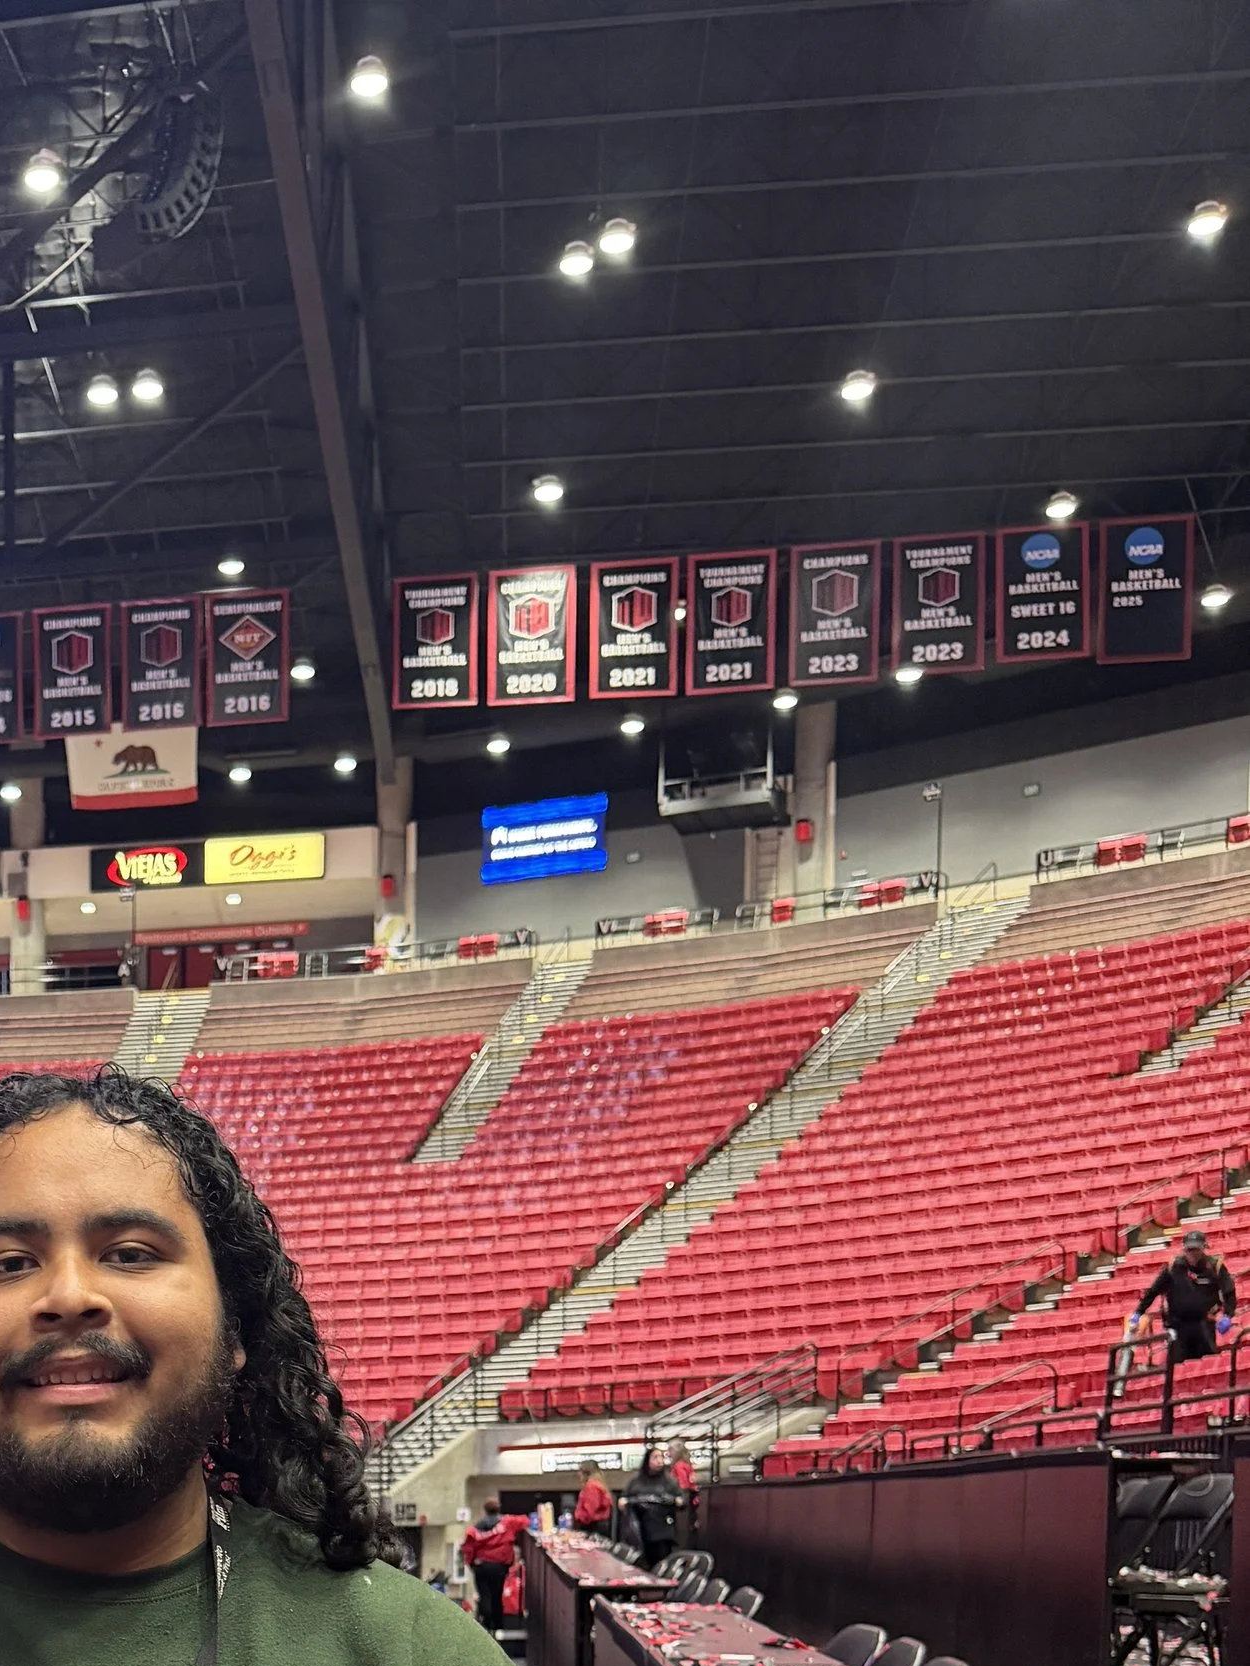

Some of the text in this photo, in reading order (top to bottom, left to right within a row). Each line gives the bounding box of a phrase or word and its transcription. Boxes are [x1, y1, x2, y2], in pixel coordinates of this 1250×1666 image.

[803, 554, 869, 569] CHAMPIONS
[910, 555, 972, 569] CHAMPIONS
[1026, 571, 1062, 583] MEN'S
[1128, 568, 1165, 581] MEN'S
[1008, 580, 1079, 596] BASKETBALL
[1111, 577, 1182, 593] BASKETBALL
[1011, 602, 1056, 619] SWEET
[904, 615, 973, 631] BASKETBALL
[800, 627, 869, 643] BASKETBALL
[1016, 629, 1070, 650] 2024
[912, 642, 964, 663] 2023
[706, 662, 752, 683] 2021
[808, 653, 859, 674] 2023
[506, 672, 557, 694] 2020
[609, 666, 656, 688] 2021
[410, 678, 459, 699] 2018
[139, 703, 184, 722] 2016
[224, 695, 271, 714] 2016
[51, 709, 96, 728] 2015
[115, 851, 178, 880] VIEJAS
[229, 844, 298, 870] Oggi's
